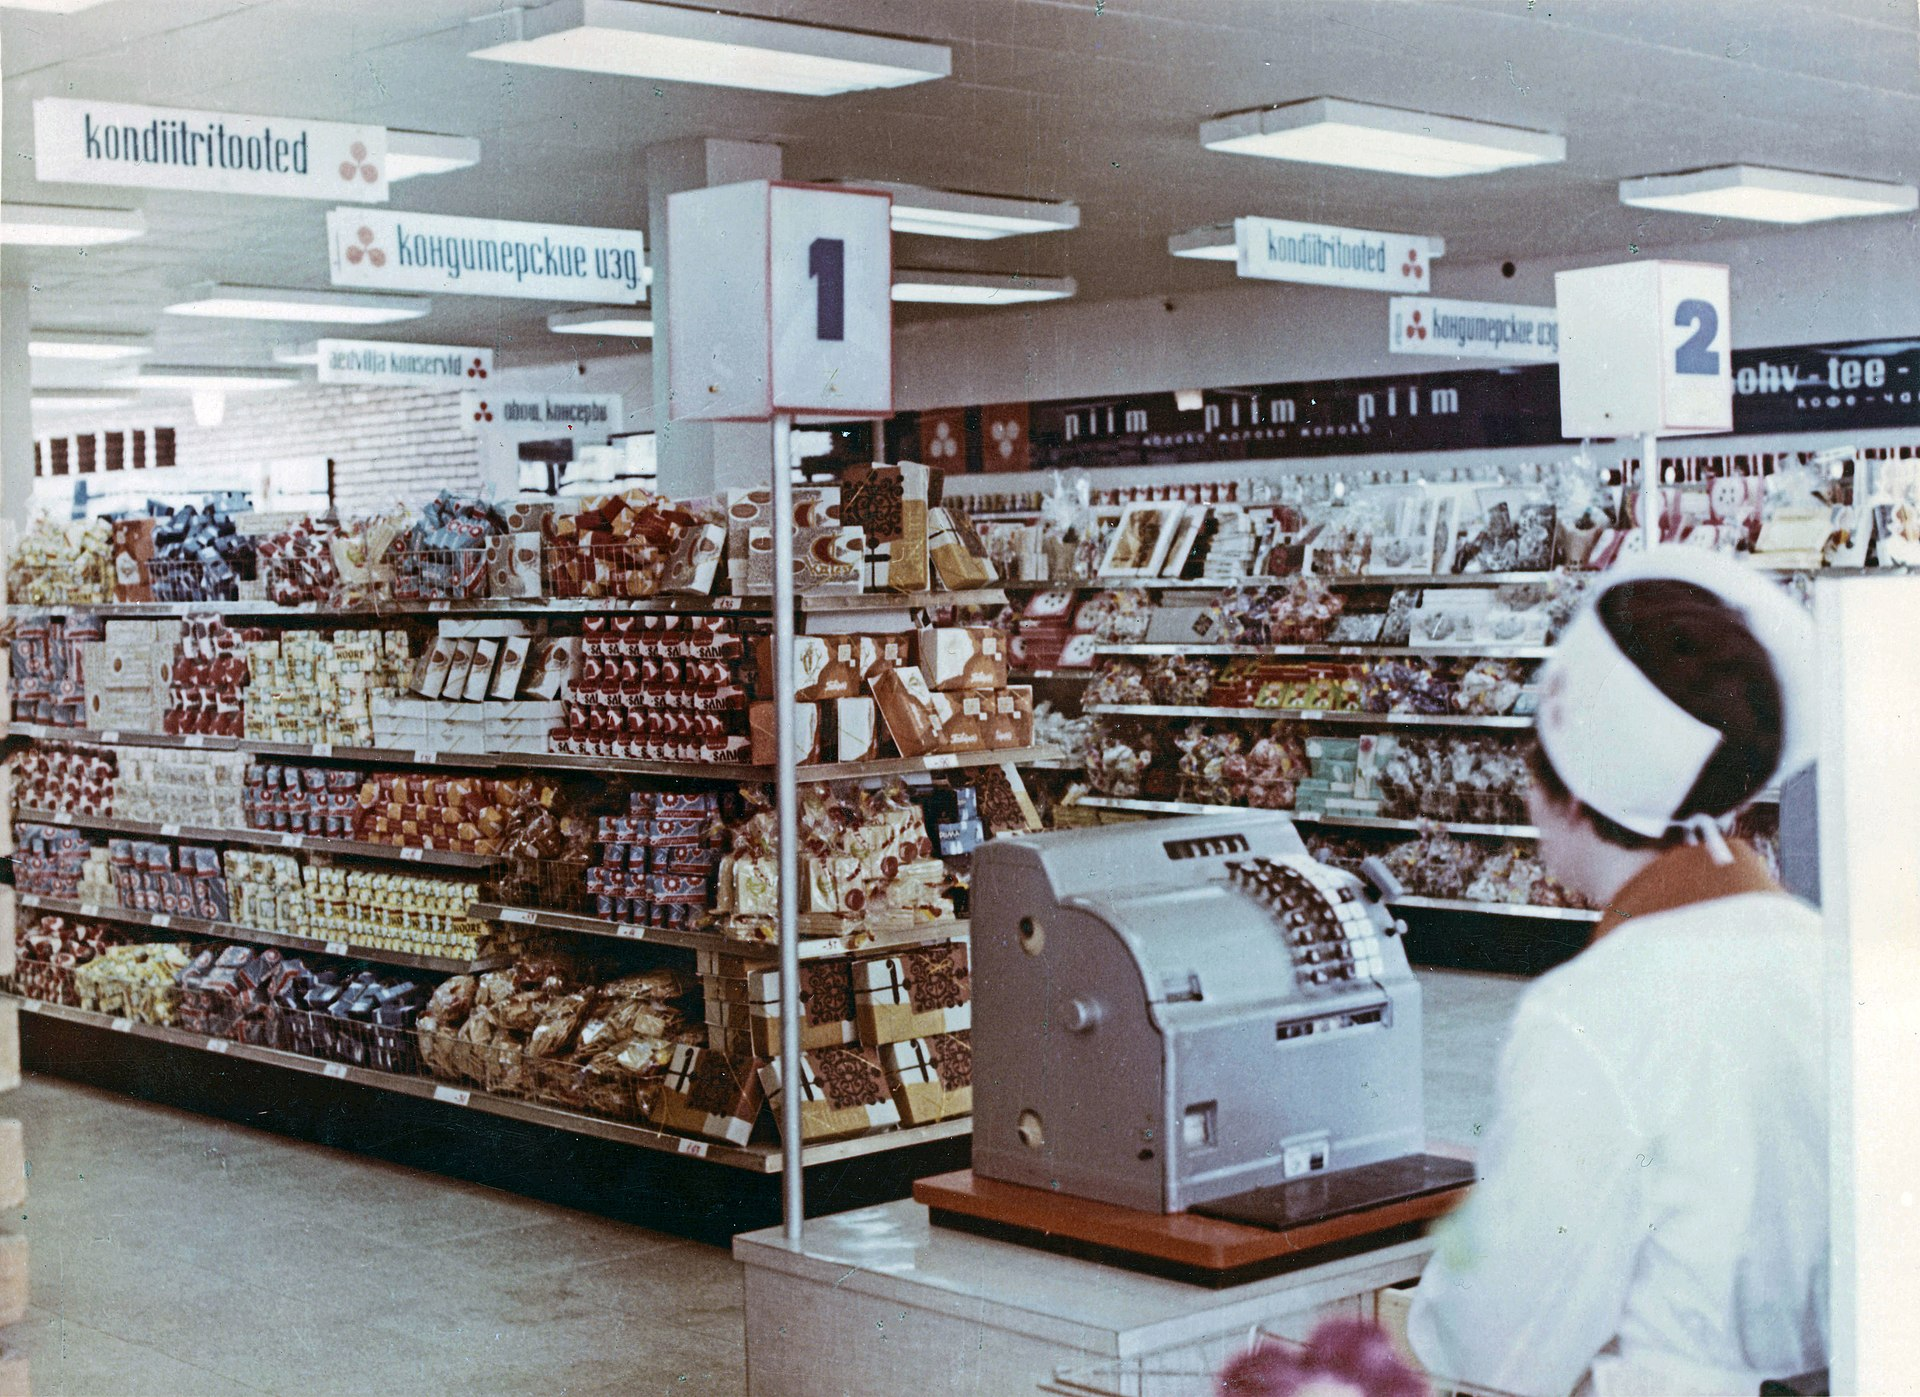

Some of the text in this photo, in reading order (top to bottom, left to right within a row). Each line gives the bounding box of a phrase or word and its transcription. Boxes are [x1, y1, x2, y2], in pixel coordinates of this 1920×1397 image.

[84, 113, 307, 174] kondiitritooted
[396, 223, 587, 283] кондитерские
[1267, 227, 1386, 274] kondiitritooted
[809, 237, 844, 341] 1
[1432, 307, 1533, 349] кондитерские
[1674, 298, 1720, 375] 2
[1731, 361, 1799, 395] ohv
[1827, 356, 1886, 390] tee
[1065, 386, 1458, 441] piim piim piim
